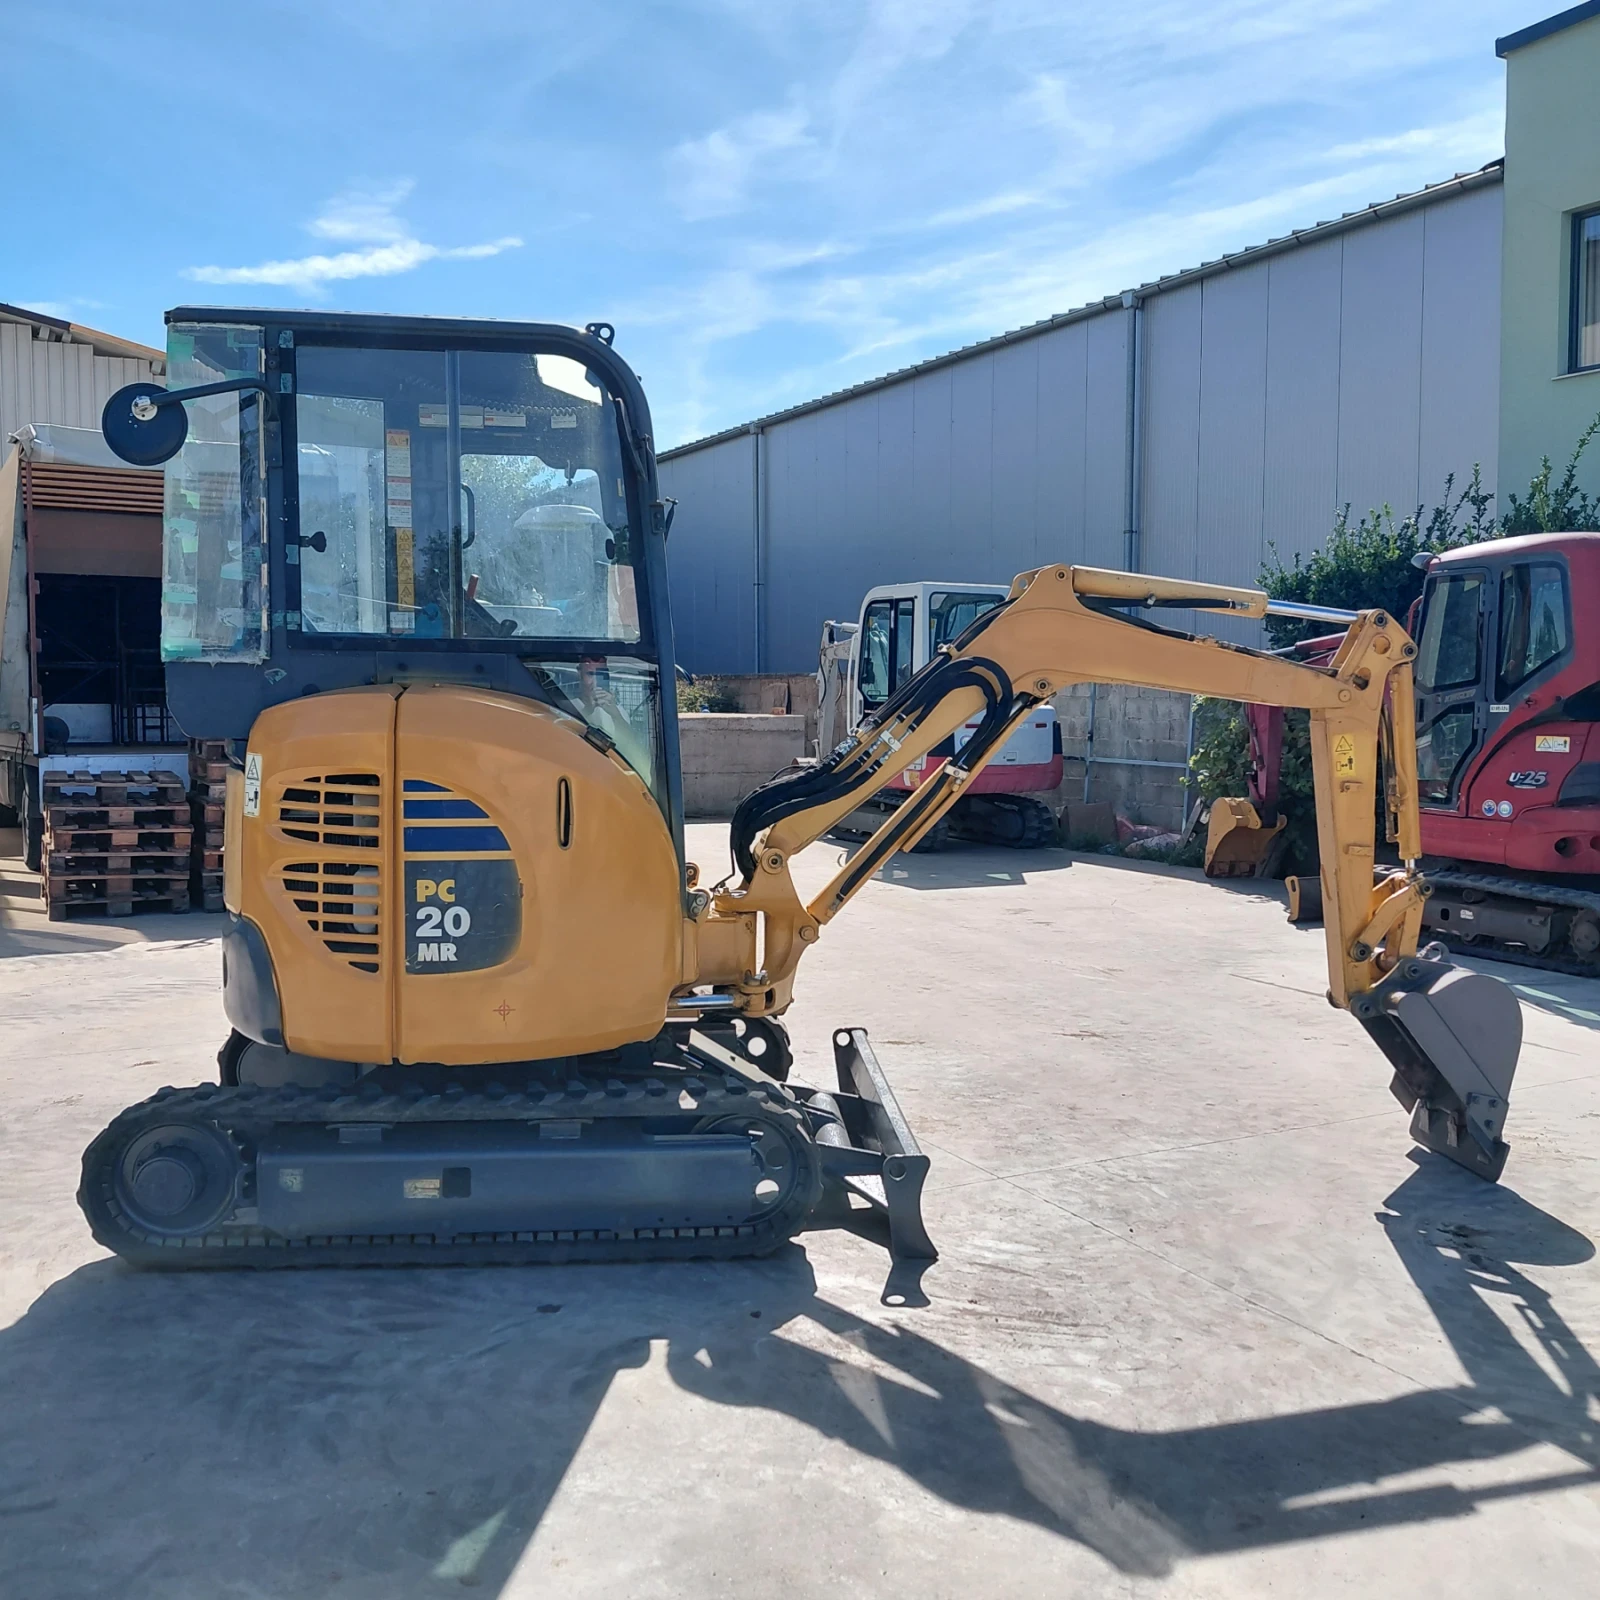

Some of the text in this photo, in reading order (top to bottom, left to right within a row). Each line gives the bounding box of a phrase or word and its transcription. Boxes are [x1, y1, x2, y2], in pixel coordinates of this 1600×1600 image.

[1508, 770, 1548, 785] U-25
[416, 879, 456, 903] PC
[415, 905, 471, 938] 20
[417, 942, 458, 962] MR
